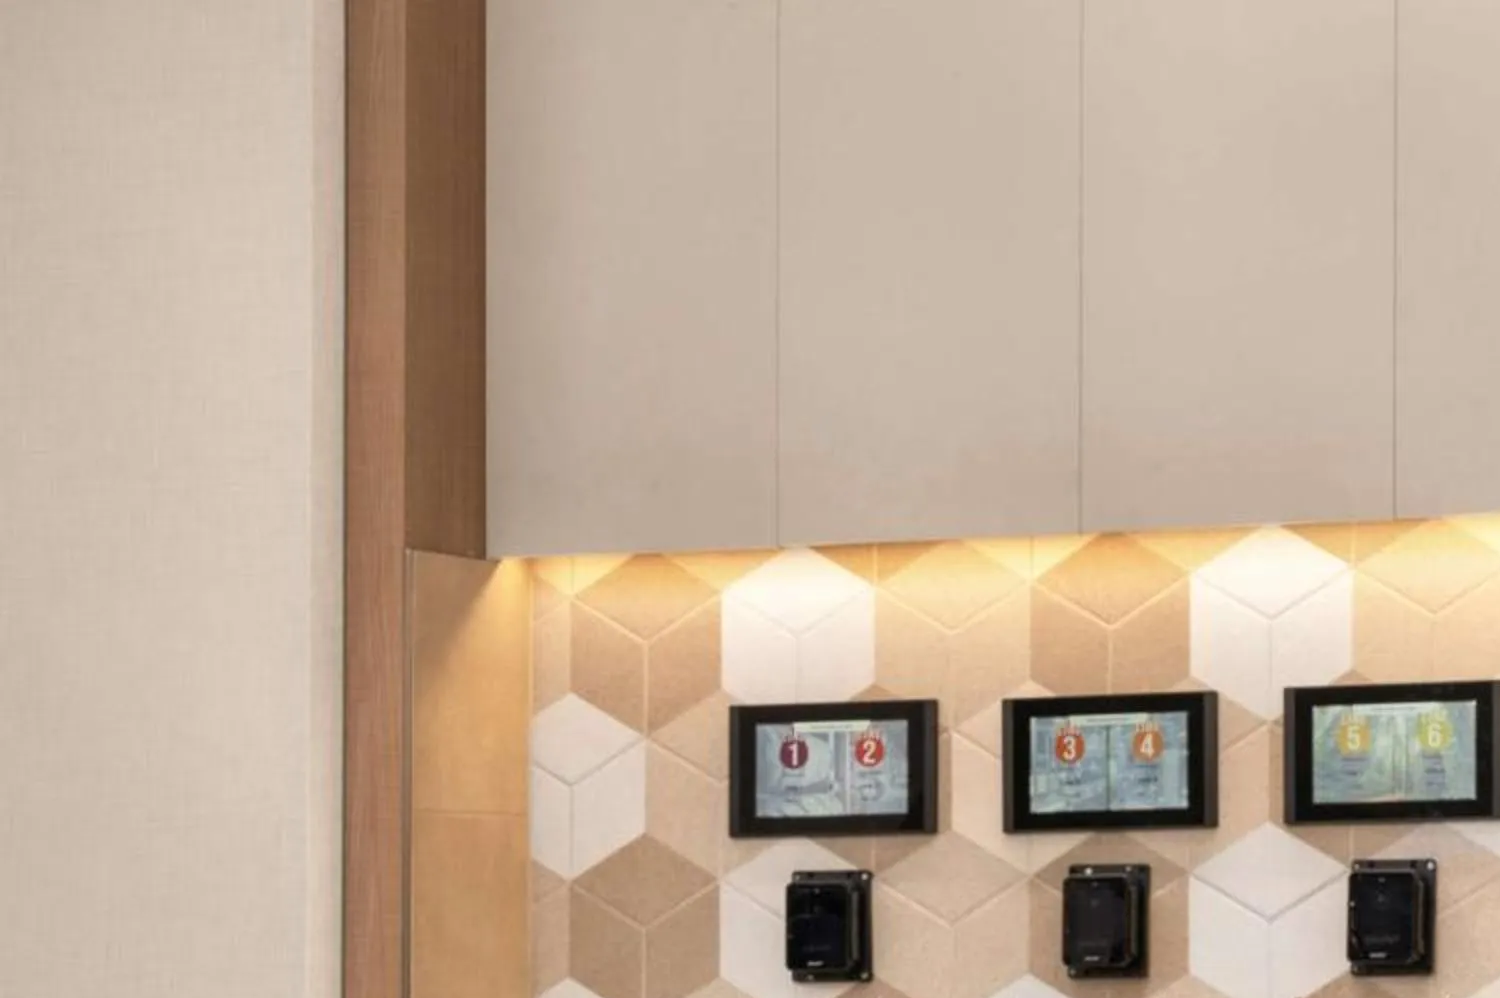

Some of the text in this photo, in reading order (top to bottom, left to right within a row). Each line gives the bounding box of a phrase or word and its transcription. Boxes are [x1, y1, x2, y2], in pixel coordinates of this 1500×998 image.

[1062, 731, 1155, 760] 3 4
[1346, 722, 1442, 751] 5 6
[786, 739, 877, 767] 1 2
